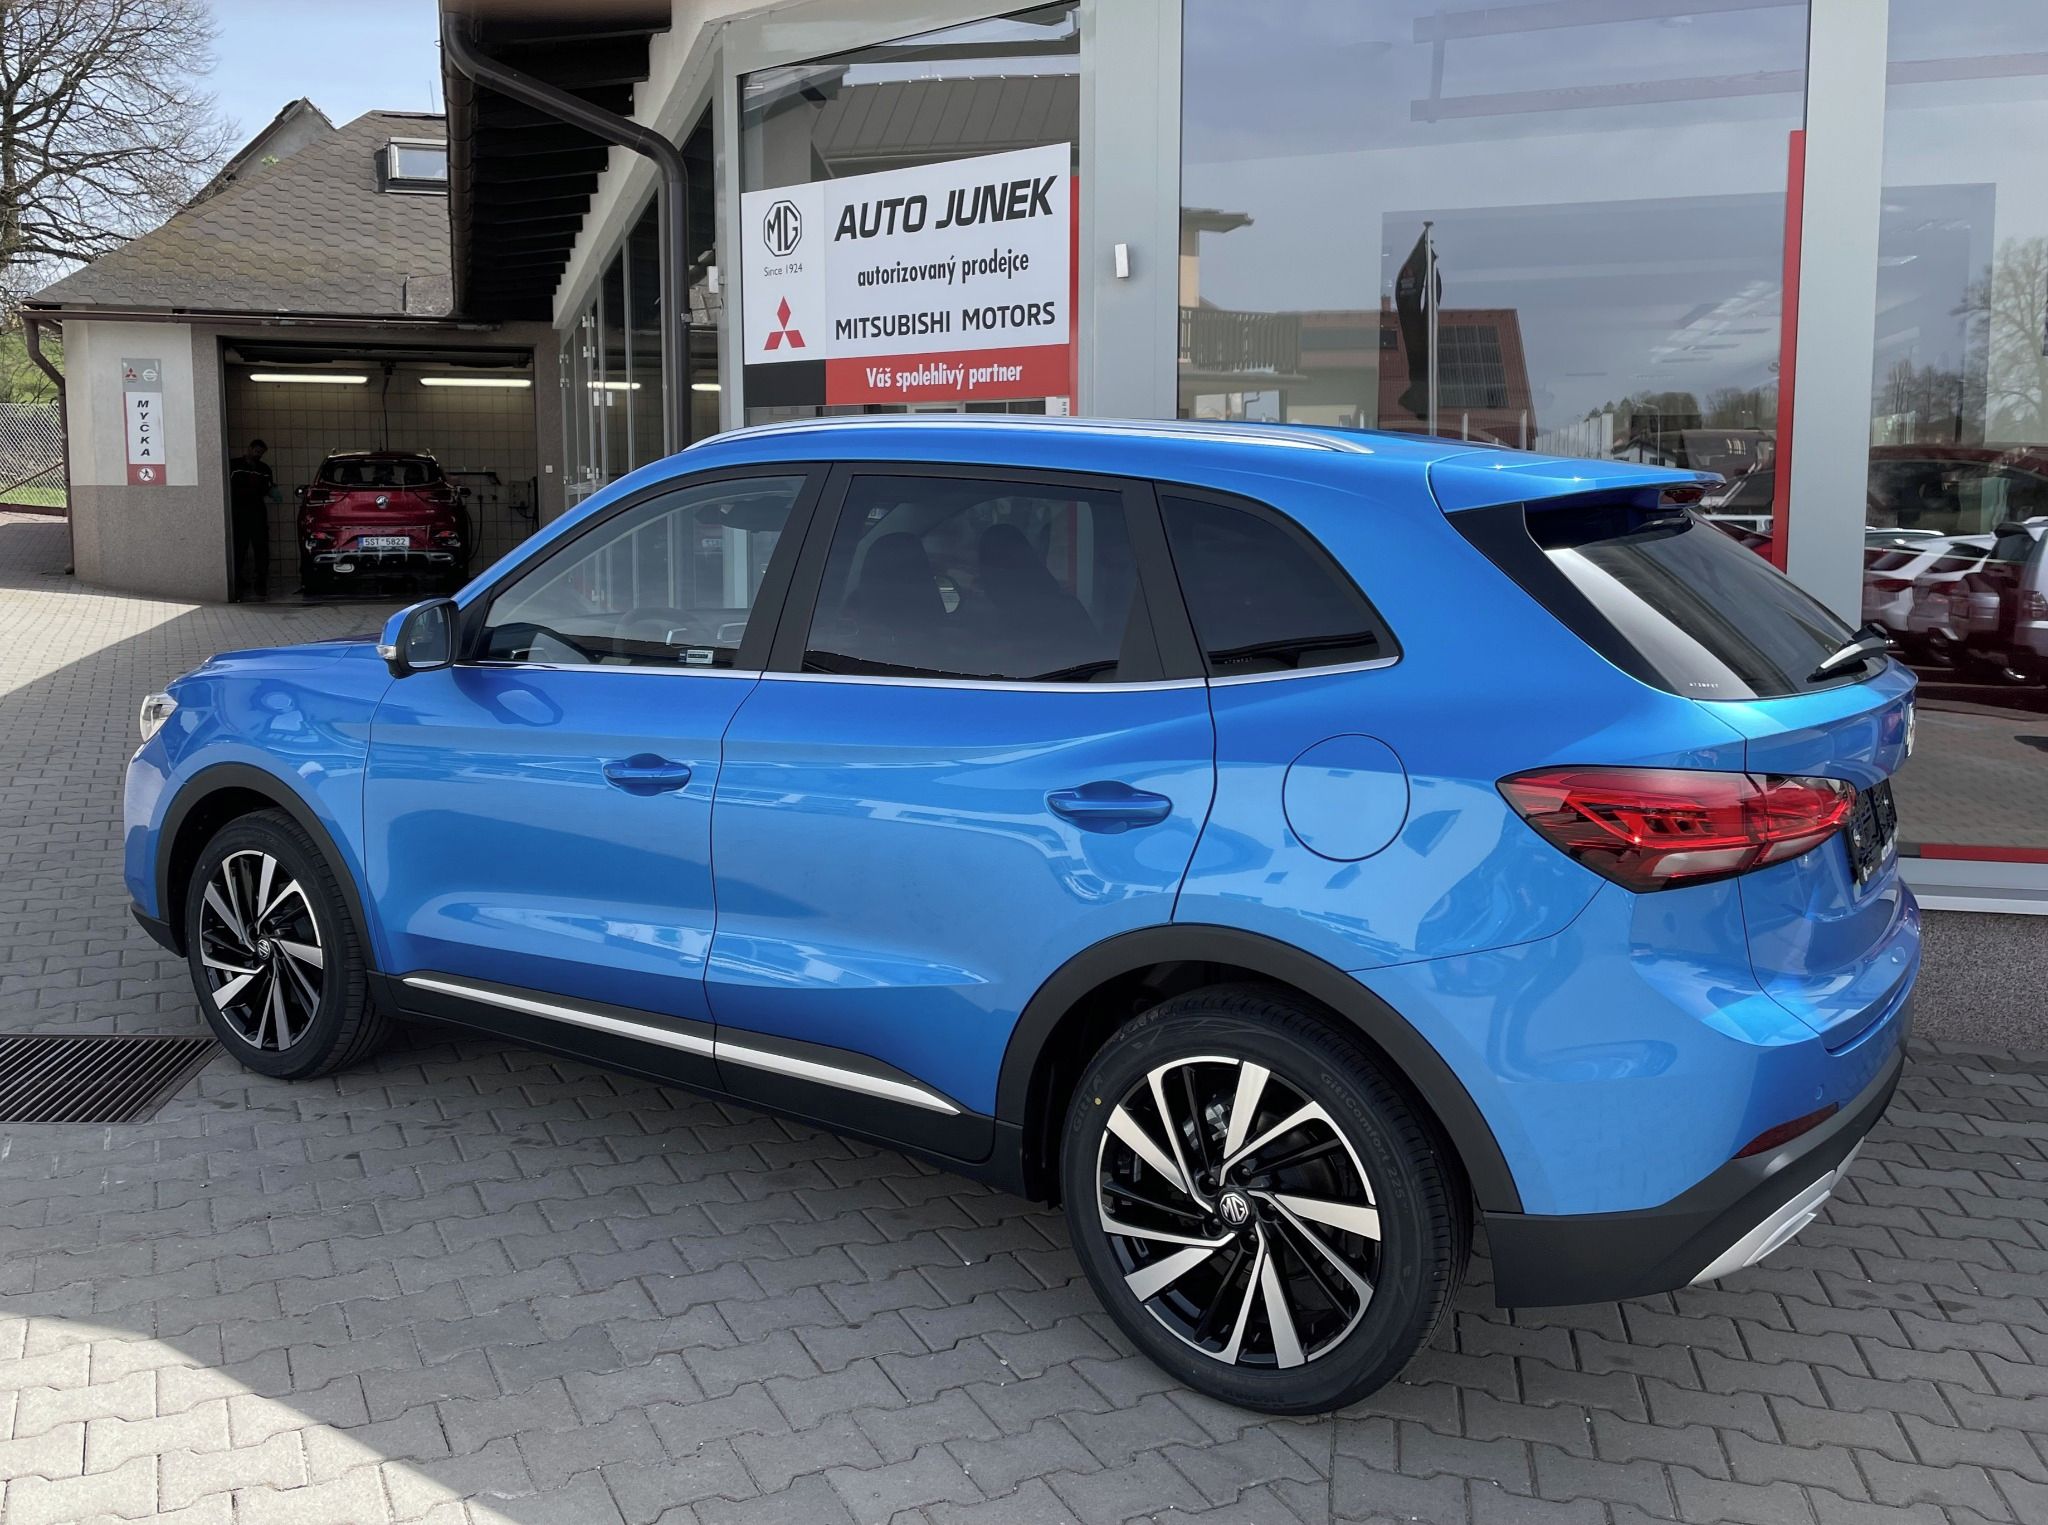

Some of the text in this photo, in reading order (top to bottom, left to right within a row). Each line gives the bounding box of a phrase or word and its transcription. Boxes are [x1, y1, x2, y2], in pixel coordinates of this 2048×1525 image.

[834, 175, 1058, 242] AUTO JUNEK
[766, 204, 800, 252] MG
[764, 263, 803, 277] Since 1924
[857, 248, 1029, 286] autorizovaný prodejce
[835, 301, 1056, 340] MITSUBISHI MOTORS
[866, 362, 1023, 392] Váš spolehlivý partner
[1221, 1195, 1247, 1223] MG
